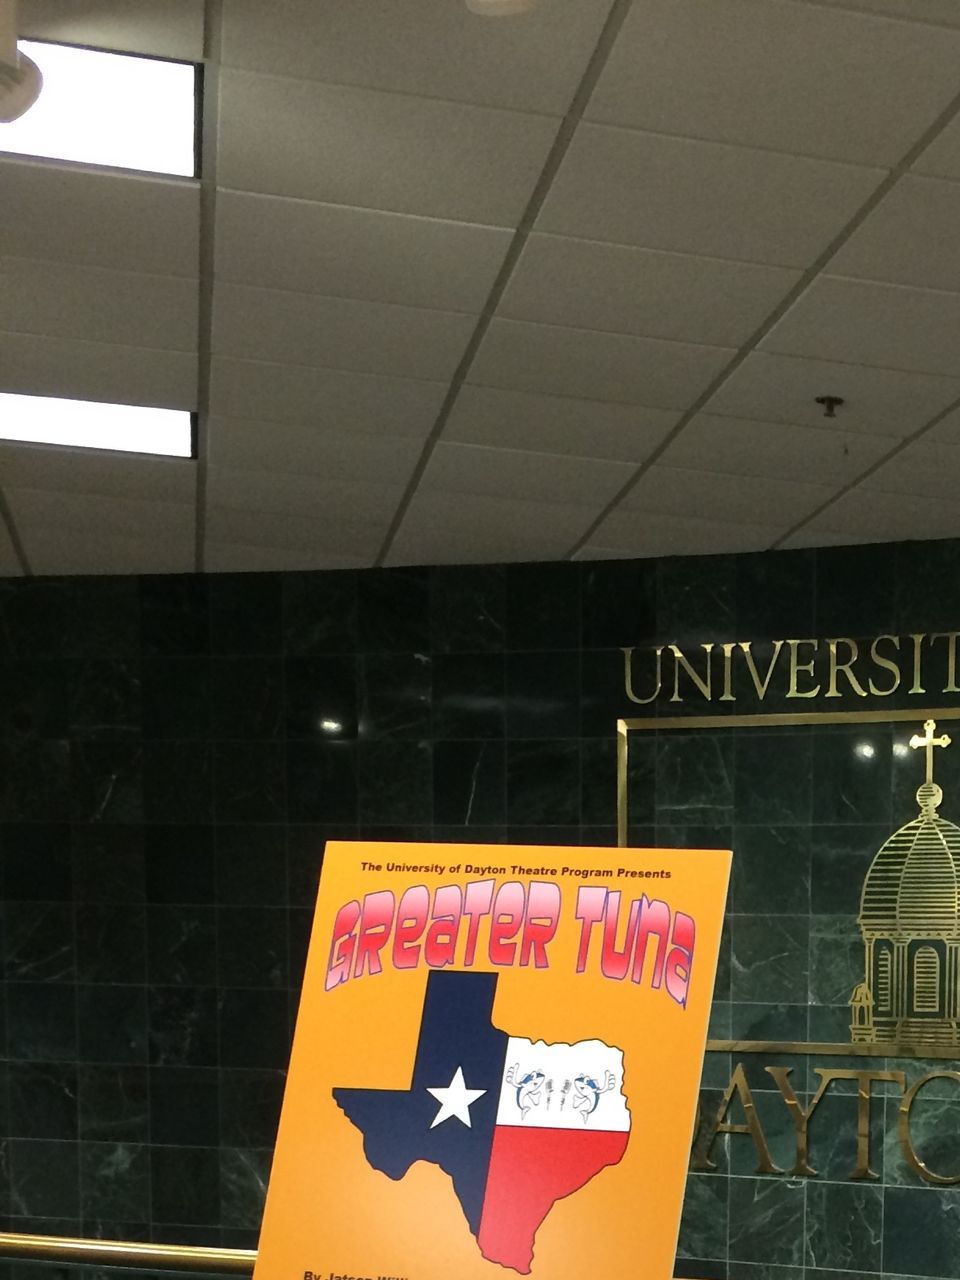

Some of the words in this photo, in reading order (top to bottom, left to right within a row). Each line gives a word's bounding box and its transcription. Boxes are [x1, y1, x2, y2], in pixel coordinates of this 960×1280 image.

[360, 862, 382, 873] The
[386, 862, 446, 875] University
[449, 864, 461, 874] of
[464, 865, 507, 877] Dayton
[511, 865, 557, 876] Theatre
[561, 867, 613, 879] Program
[616, 868, 672, 879] Presents
